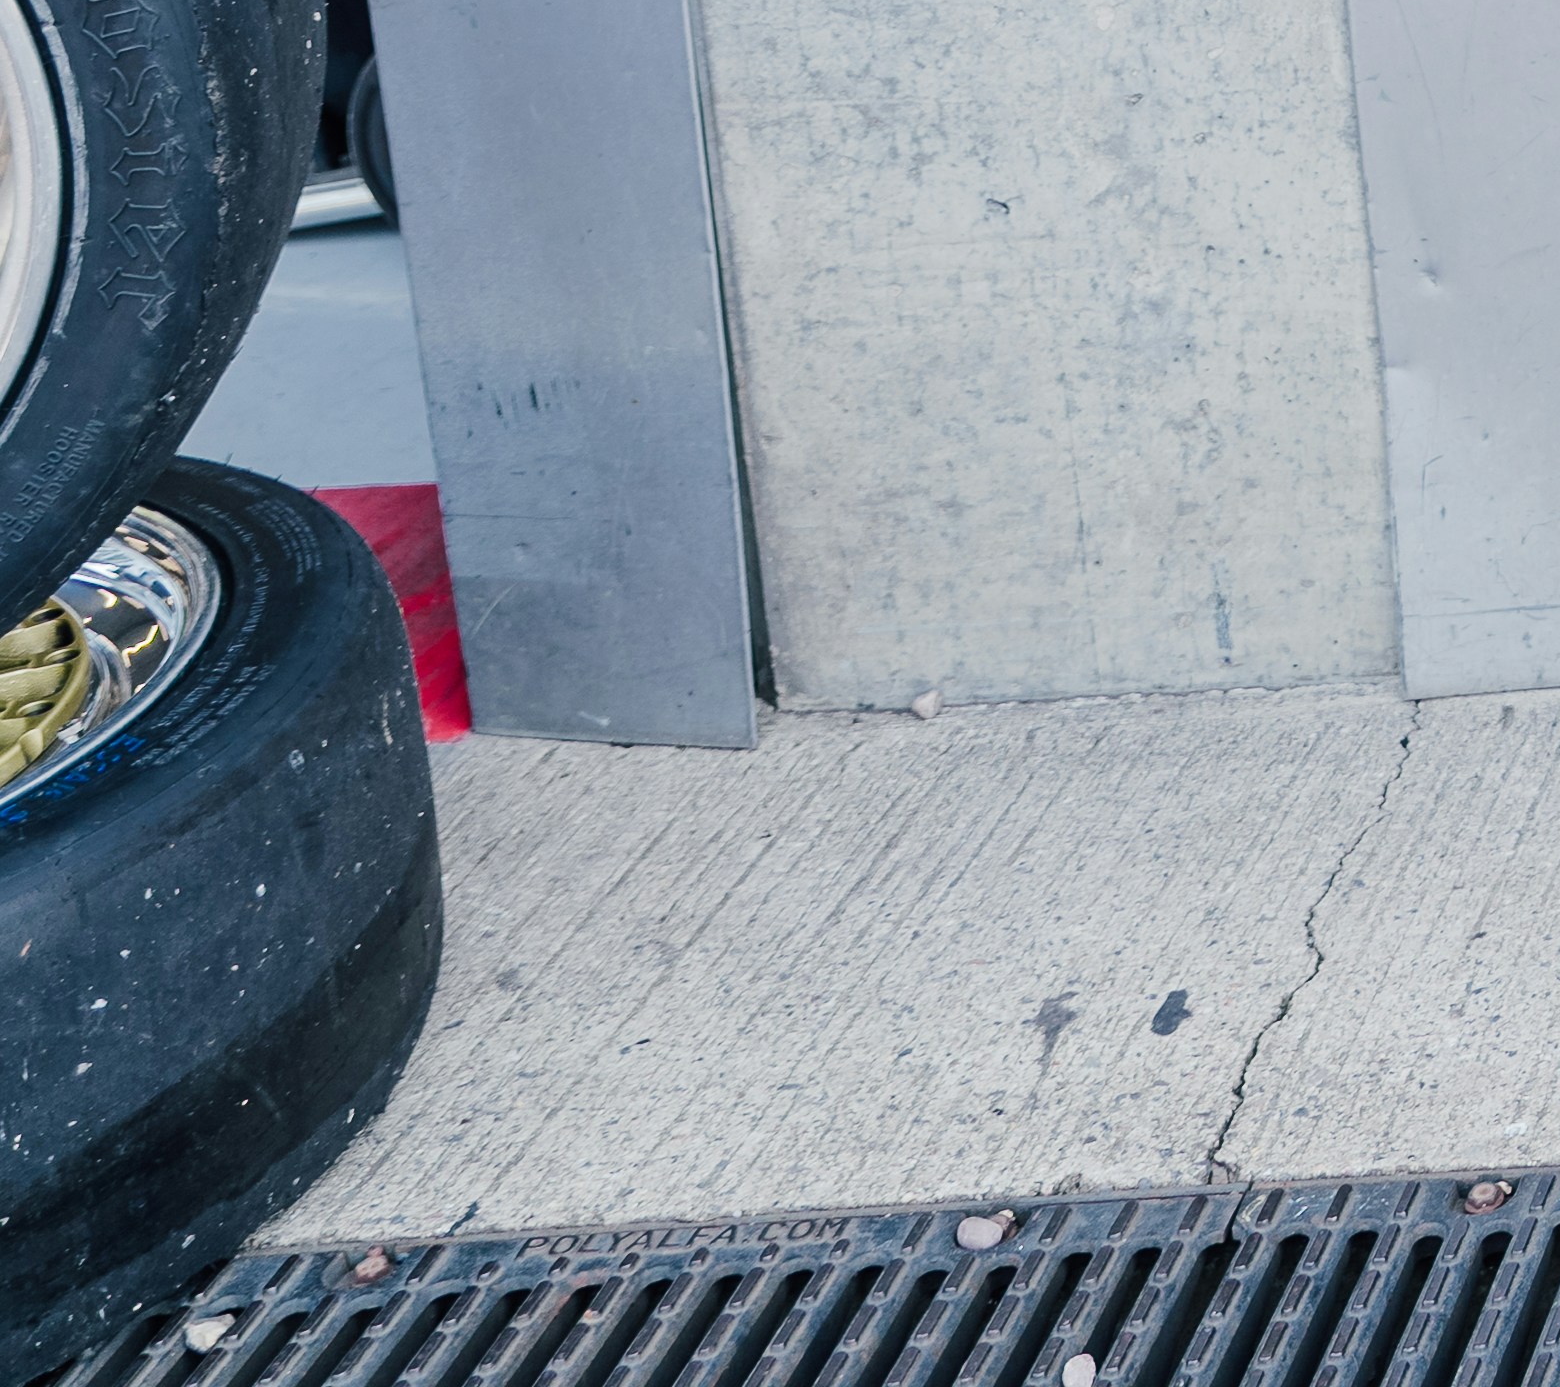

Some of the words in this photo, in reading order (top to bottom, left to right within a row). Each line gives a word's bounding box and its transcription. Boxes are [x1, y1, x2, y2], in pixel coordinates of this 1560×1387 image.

[5, 415, 107, 546] MANUFACTURED
[10, 425, 78, 509] HOOSIER
[517, 1217, 847, 1258] POLYALFA.COM
